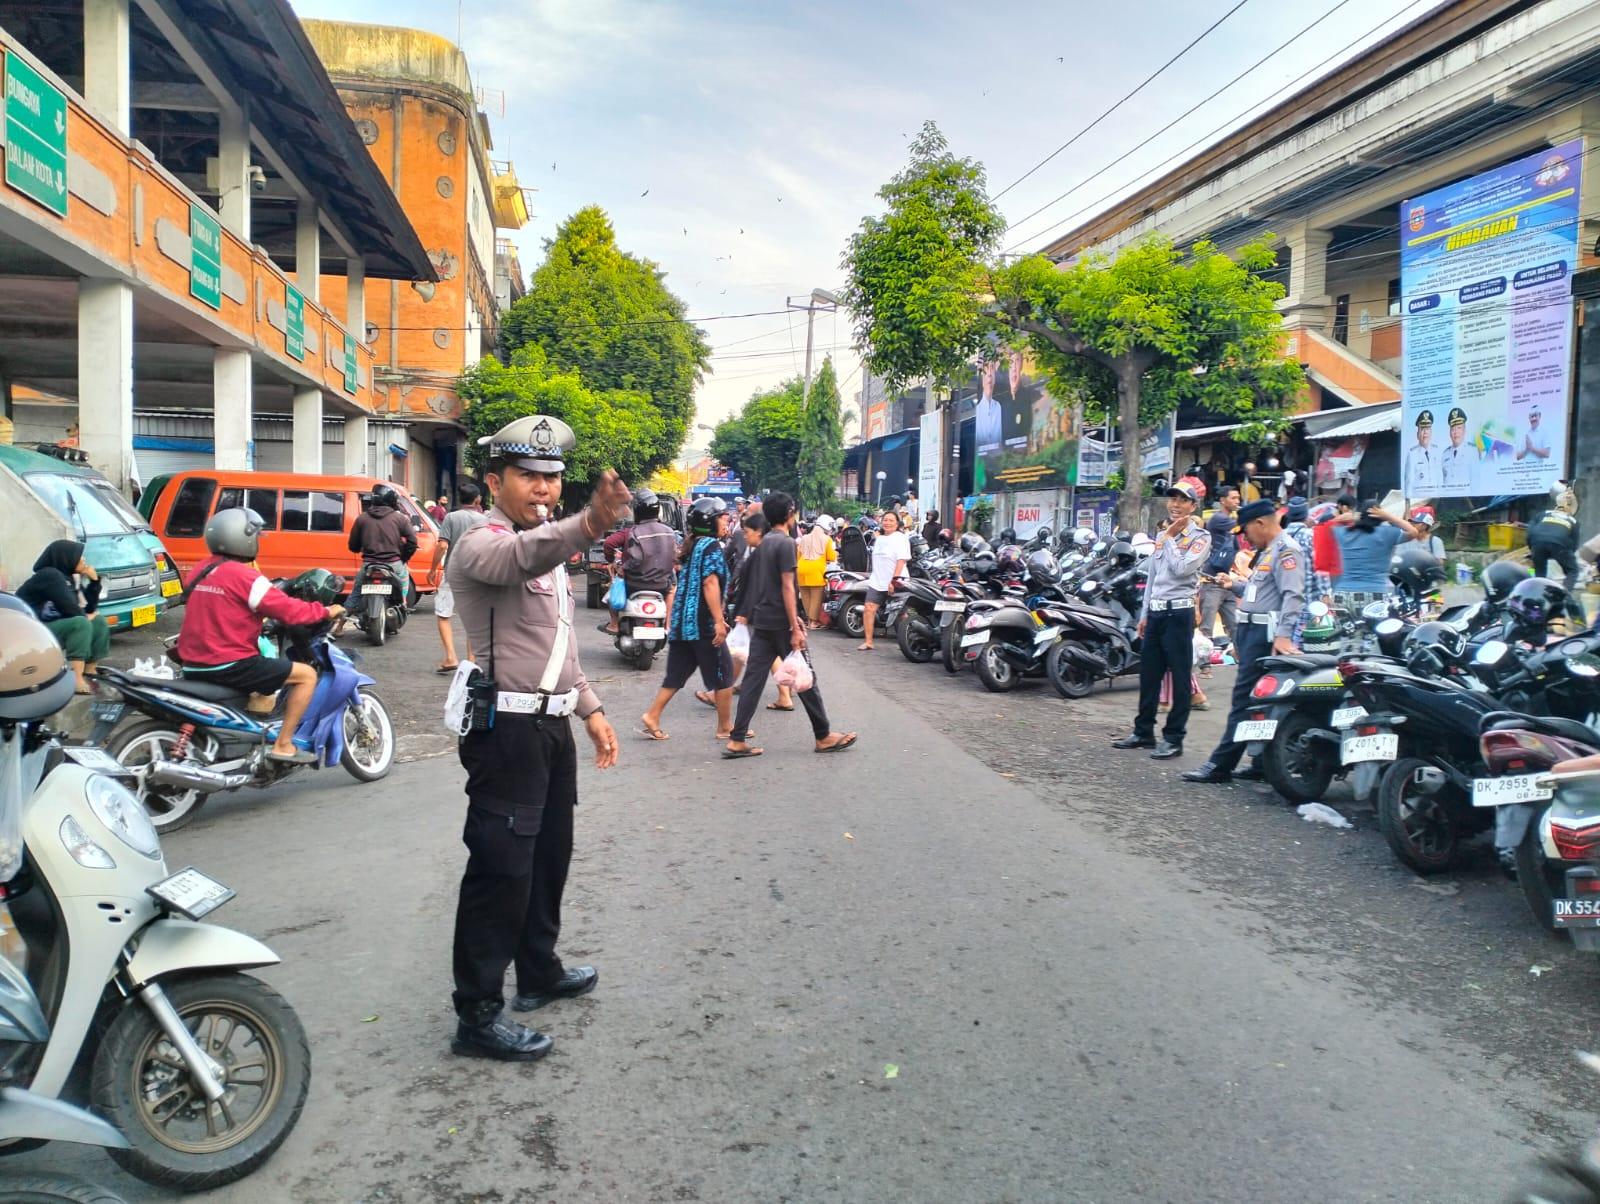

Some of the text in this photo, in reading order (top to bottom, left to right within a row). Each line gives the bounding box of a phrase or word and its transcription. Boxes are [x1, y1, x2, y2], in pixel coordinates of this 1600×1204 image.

[7, 139, 54, 189] DALAM KOTA
[1017, 508, 1040, 522] BANI
[1476, 778, 1529, 793] DK 2959
[1556, 901, 1573, 915] DK
